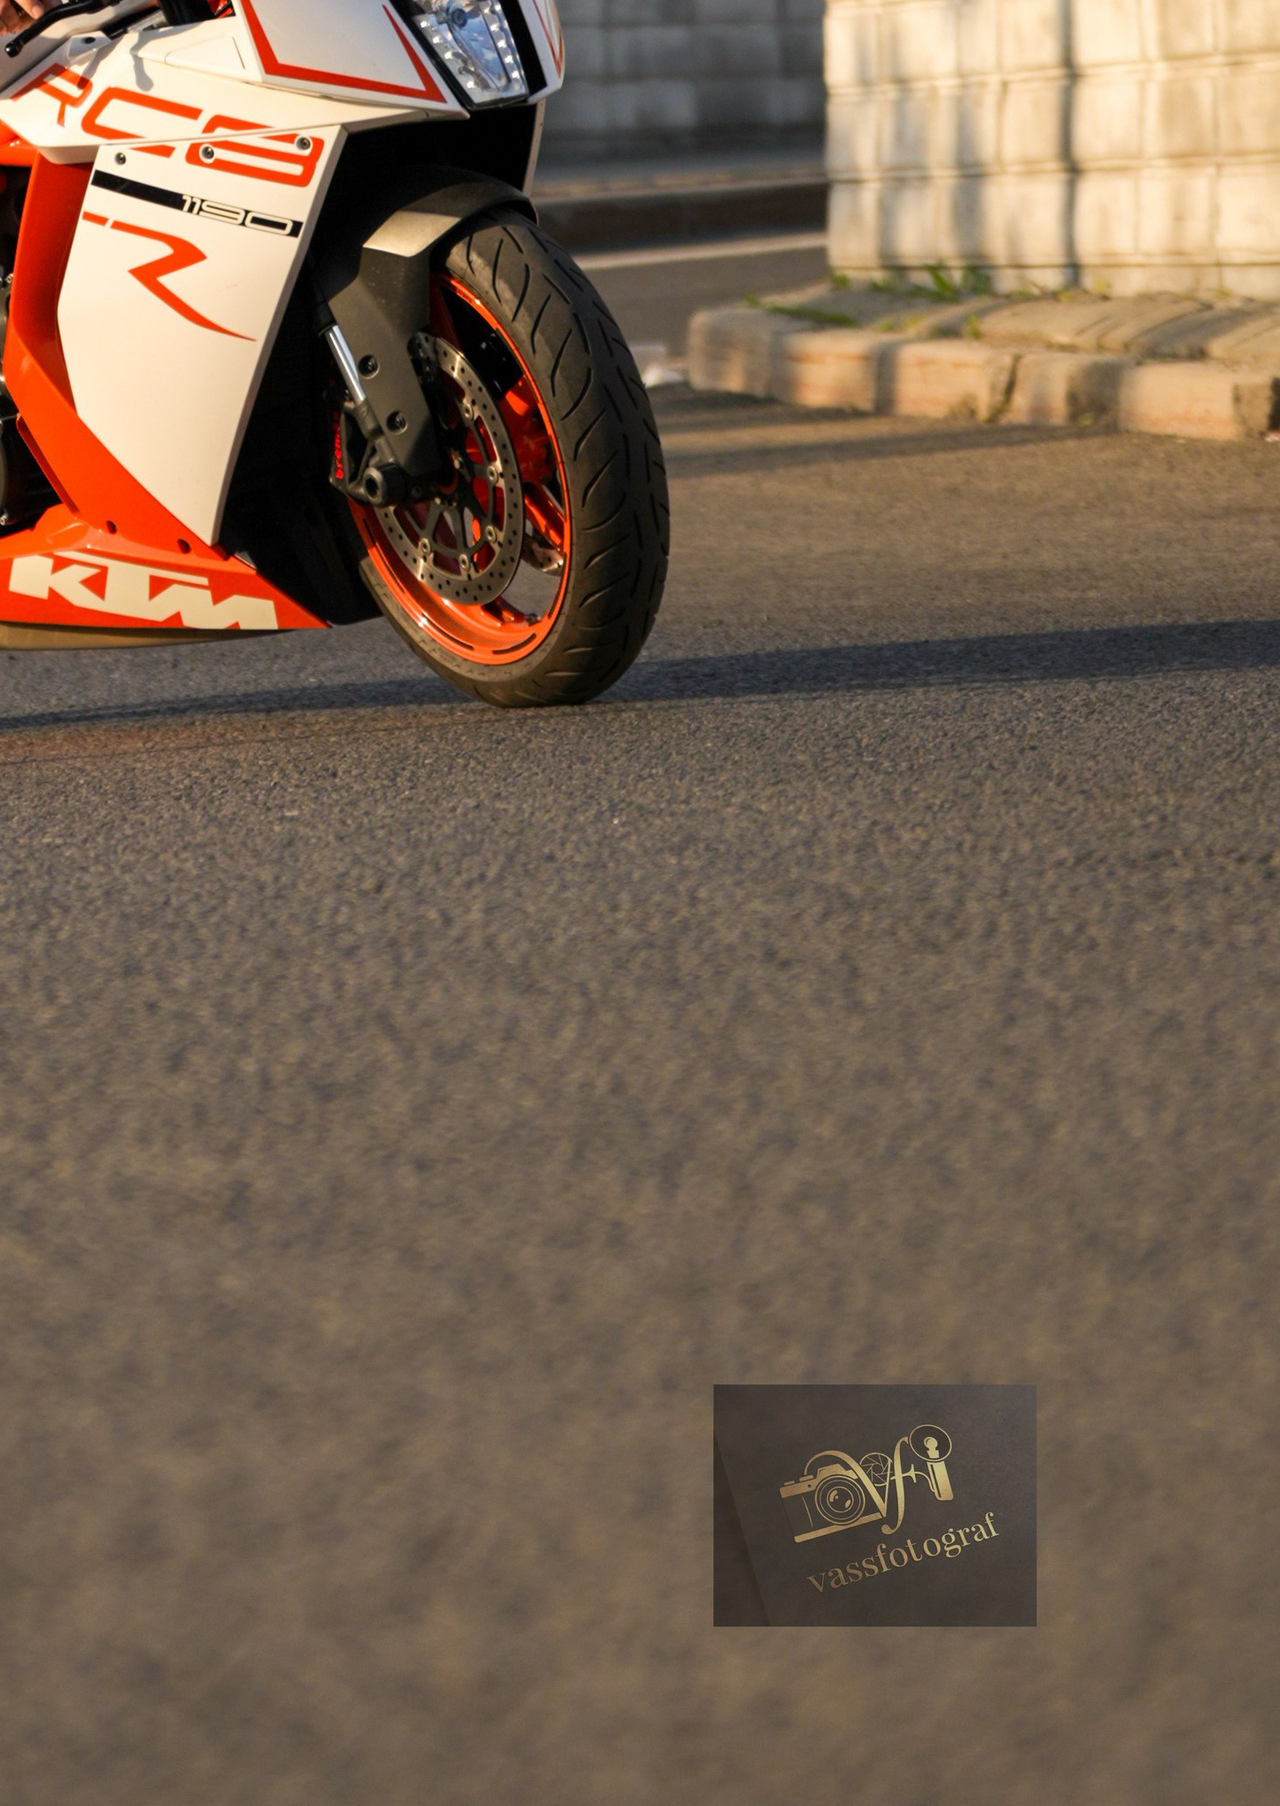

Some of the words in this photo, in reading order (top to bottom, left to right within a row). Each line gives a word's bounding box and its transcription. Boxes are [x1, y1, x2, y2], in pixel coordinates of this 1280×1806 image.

[9, 62, 325, 188] RC8
[182, 195, 293, 236] 1190
[8, 550, 279, 630] KTM
